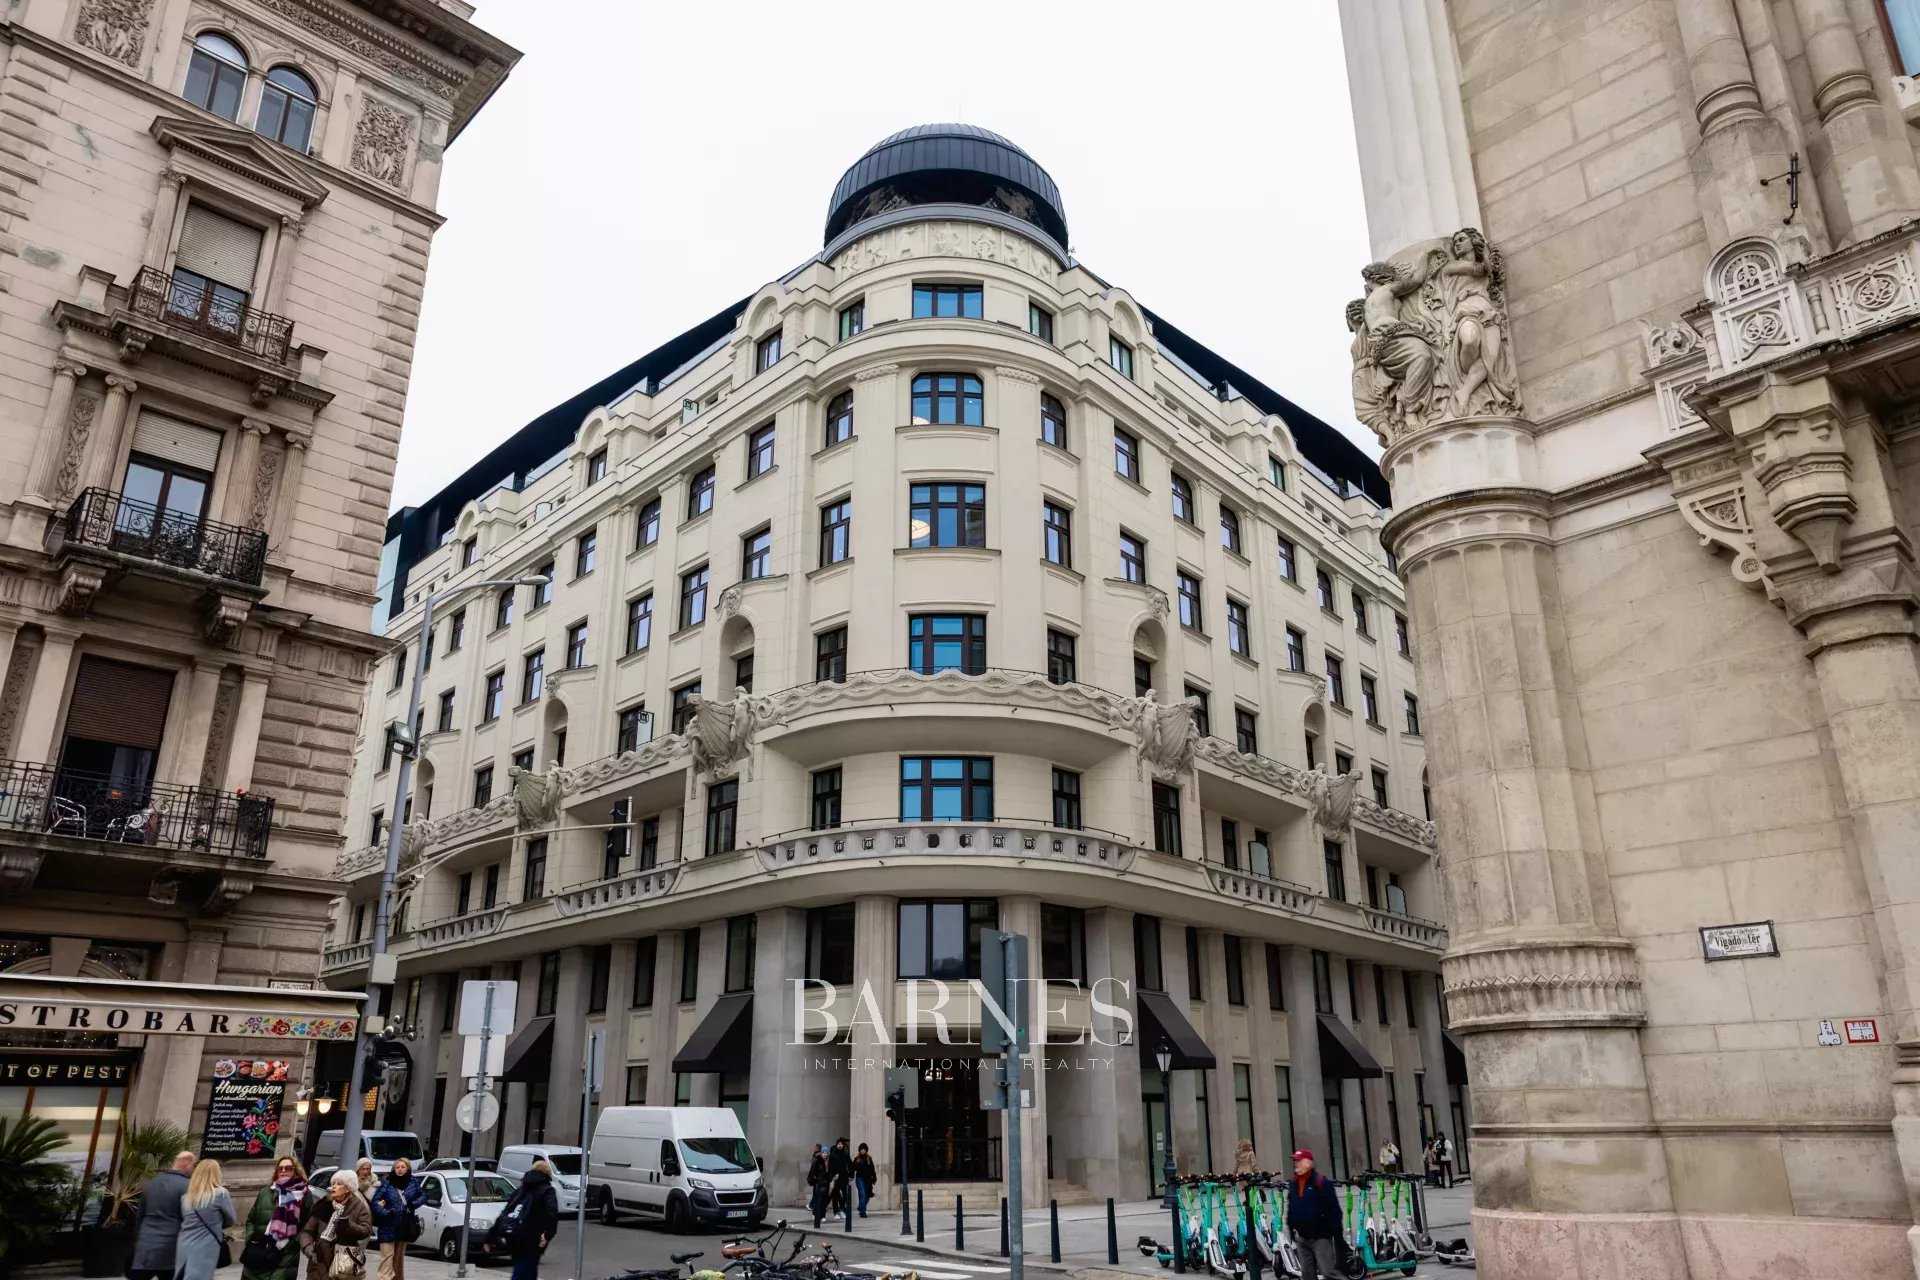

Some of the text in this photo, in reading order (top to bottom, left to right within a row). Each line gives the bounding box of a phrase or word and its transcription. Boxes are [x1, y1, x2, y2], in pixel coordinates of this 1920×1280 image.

[0, 1004, 230, 1034] STROBAR
[27, 1064, 59, 1078] OF
[67, 1064, 126, 1079] PEST
[215, 1080, 283, 1097] Hungarian
